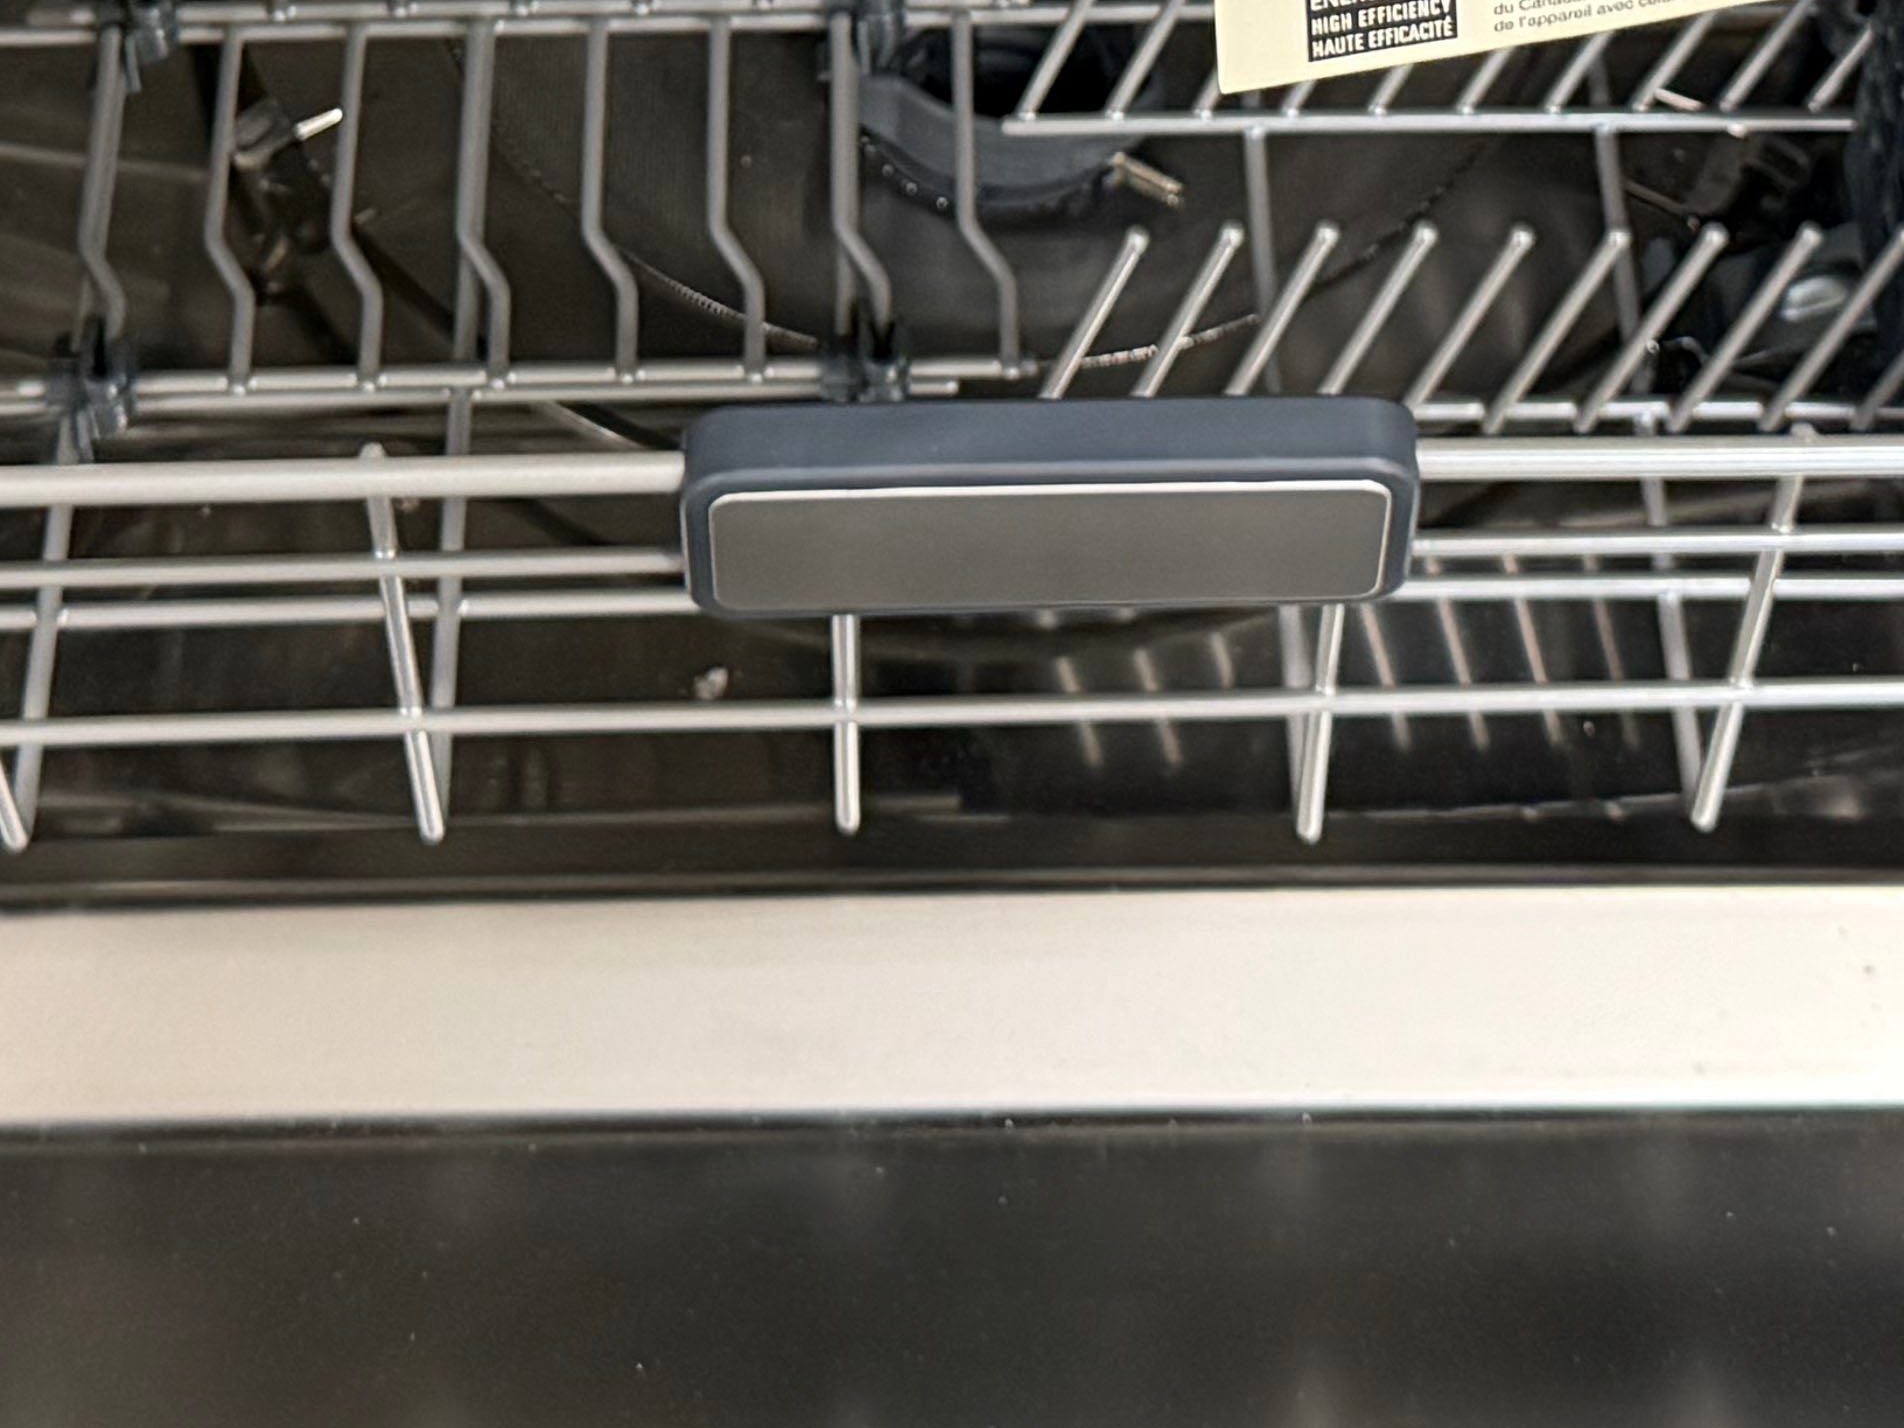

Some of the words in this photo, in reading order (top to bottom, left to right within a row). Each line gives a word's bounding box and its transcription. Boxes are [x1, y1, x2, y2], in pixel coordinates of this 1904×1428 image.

[1311, 13, 1353, 36] HIGH
[1311, 33, 1365, 59] HAUTE
[1368, 15, 1454, 49] EFFICACITÉ
